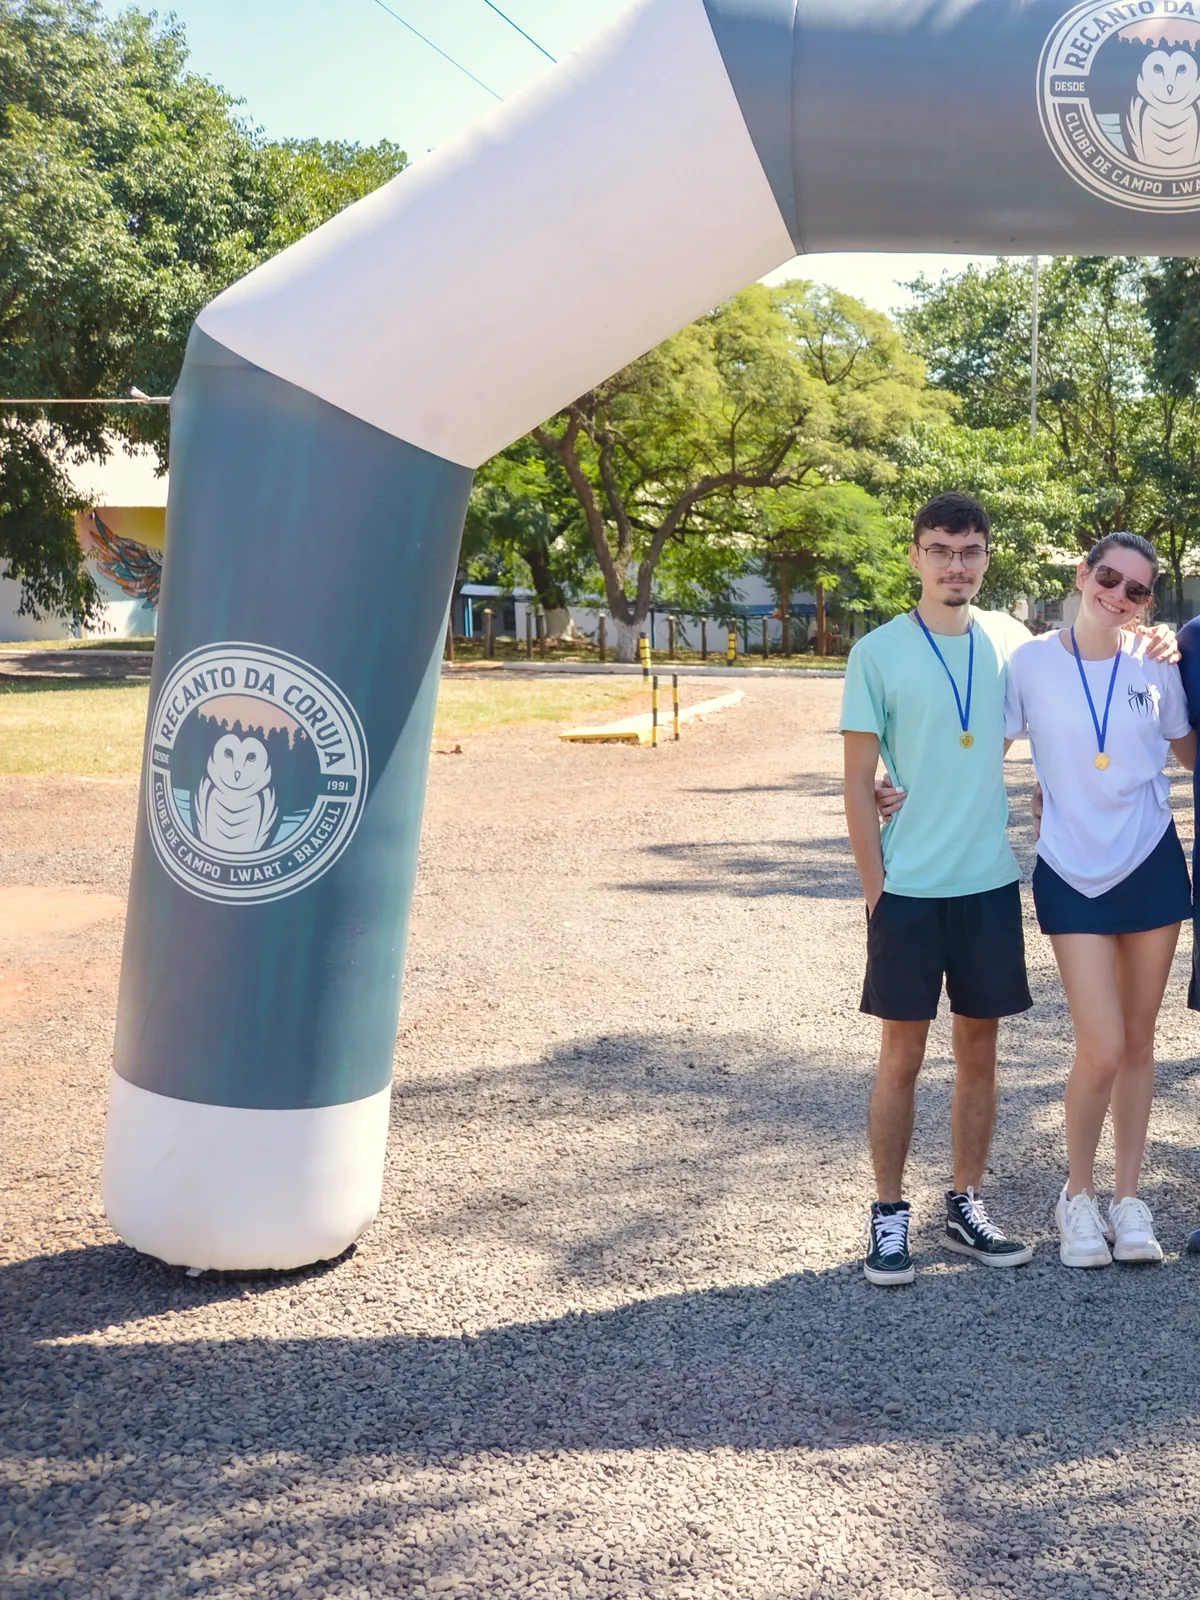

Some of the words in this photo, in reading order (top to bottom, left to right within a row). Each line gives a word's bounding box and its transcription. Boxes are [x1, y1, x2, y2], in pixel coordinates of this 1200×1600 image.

[1064, 1, 1155, 70] RECANTO
[1163, 0, 1194, 16] DA
[1054, 81, 1085, 92] DESDE
[1065, 111, 1092, 159] CLUBE
[1092, 155, 1112, 175] DE
[1111, 169, 1162, 194] CAMPO
[161, 666, 235, 742] RECANTO
[243, 667, 276, 697] DA
[282, 685, 346, 768] CORUJA
[327, 780, 349, 791] 1991
[155, 781, 170, 830] CLUBE
[166, 830, 178, 848] DE
[177, 846, 221, 879] CAMPO
[229, 861, 284, 882] LWART
[292, 807, 341, 864] BRACELL
